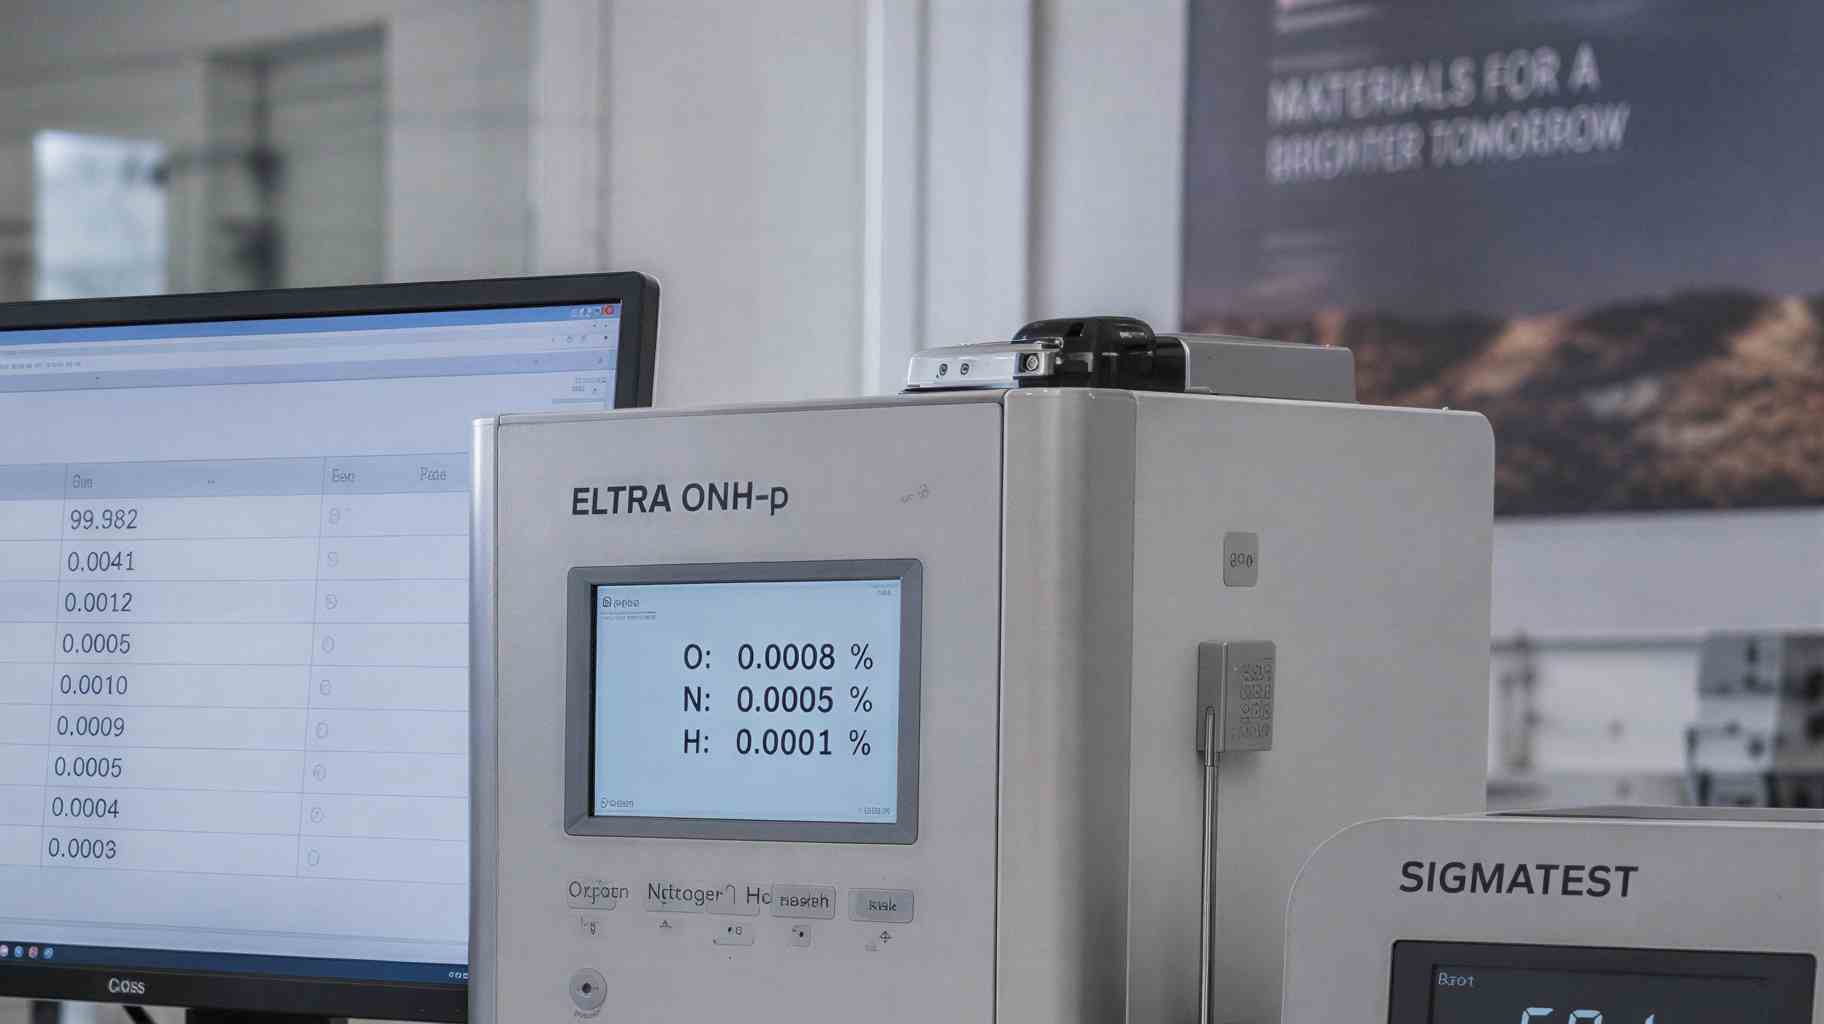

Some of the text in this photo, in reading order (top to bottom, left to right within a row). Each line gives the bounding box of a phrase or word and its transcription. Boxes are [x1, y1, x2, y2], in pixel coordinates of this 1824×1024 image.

[1568, 43, 1600, 92] A
[571, 480, 790, 517] ELTRA ONH-p
[70, 508, 138, 531] 99.982
[67, 550, 136, 572] 0.0041
[64, 592, 133, 614] 0.0012
[62, 632, 131, 655] 0.0005
[737, 643, 836, 671] 0.0008
[850, 643, 874, 671] %
[60, 674, 128, 696] 0.0010
[683, 685, 873, 714] N: 0.0005 %
[56, 715, 125, 738] 0.0009
[683, 728, 872, 756] H: 0.0001 %
[54, 756, 123, 779] 0.0005
[51, 796, 120, 819] 0.0004
[48, 837, 117, 860] 0.0003
[1399, 860, 1639, 898] SIGMATEST
